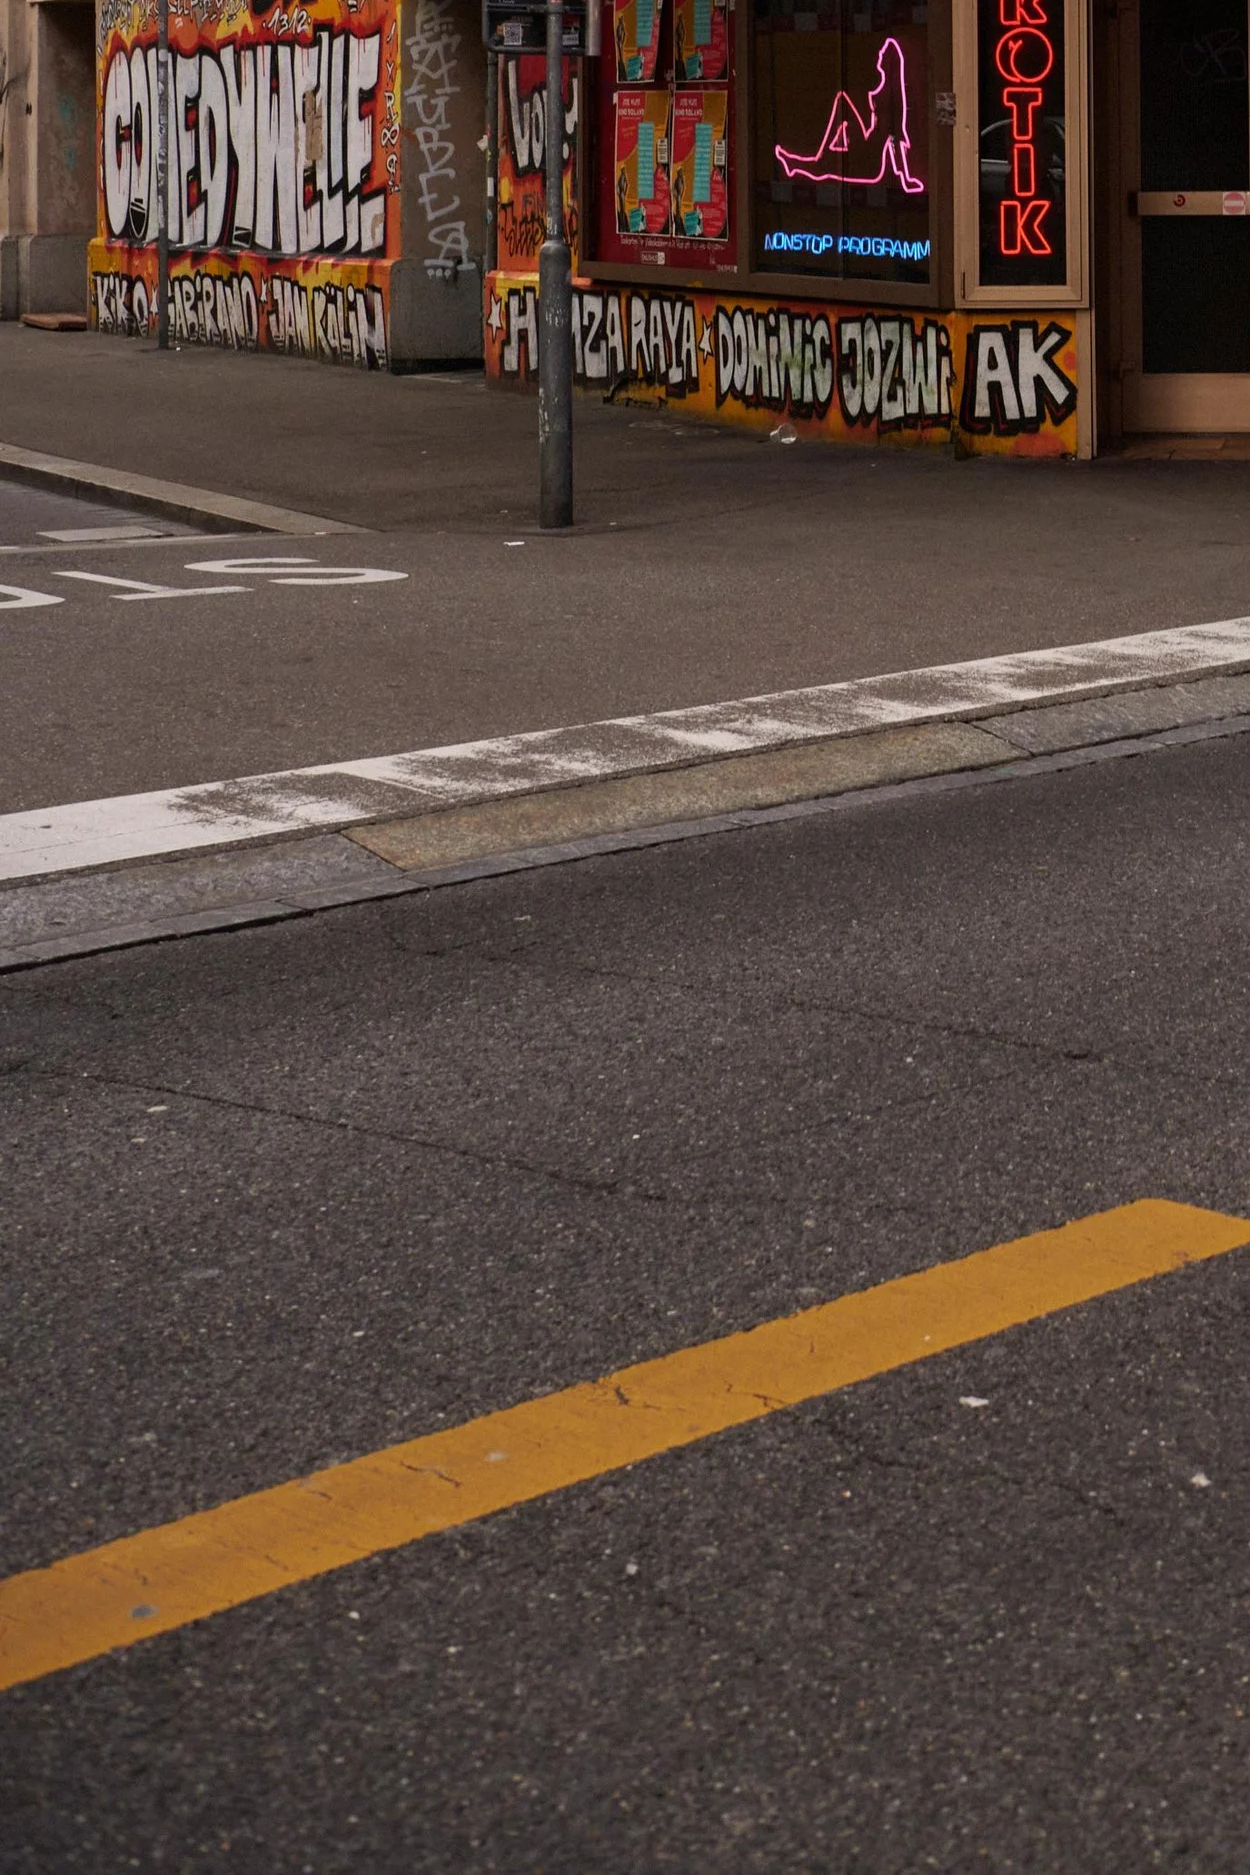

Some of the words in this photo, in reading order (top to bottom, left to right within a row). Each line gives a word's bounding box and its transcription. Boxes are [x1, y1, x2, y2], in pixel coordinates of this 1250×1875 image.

[764, 231, 834, 255] NONSTOP
[837, 236, 931, 261] PROGRAMM
[629, 295, 699, 385] RAYA
[972, 323, 1072, 421] AK
